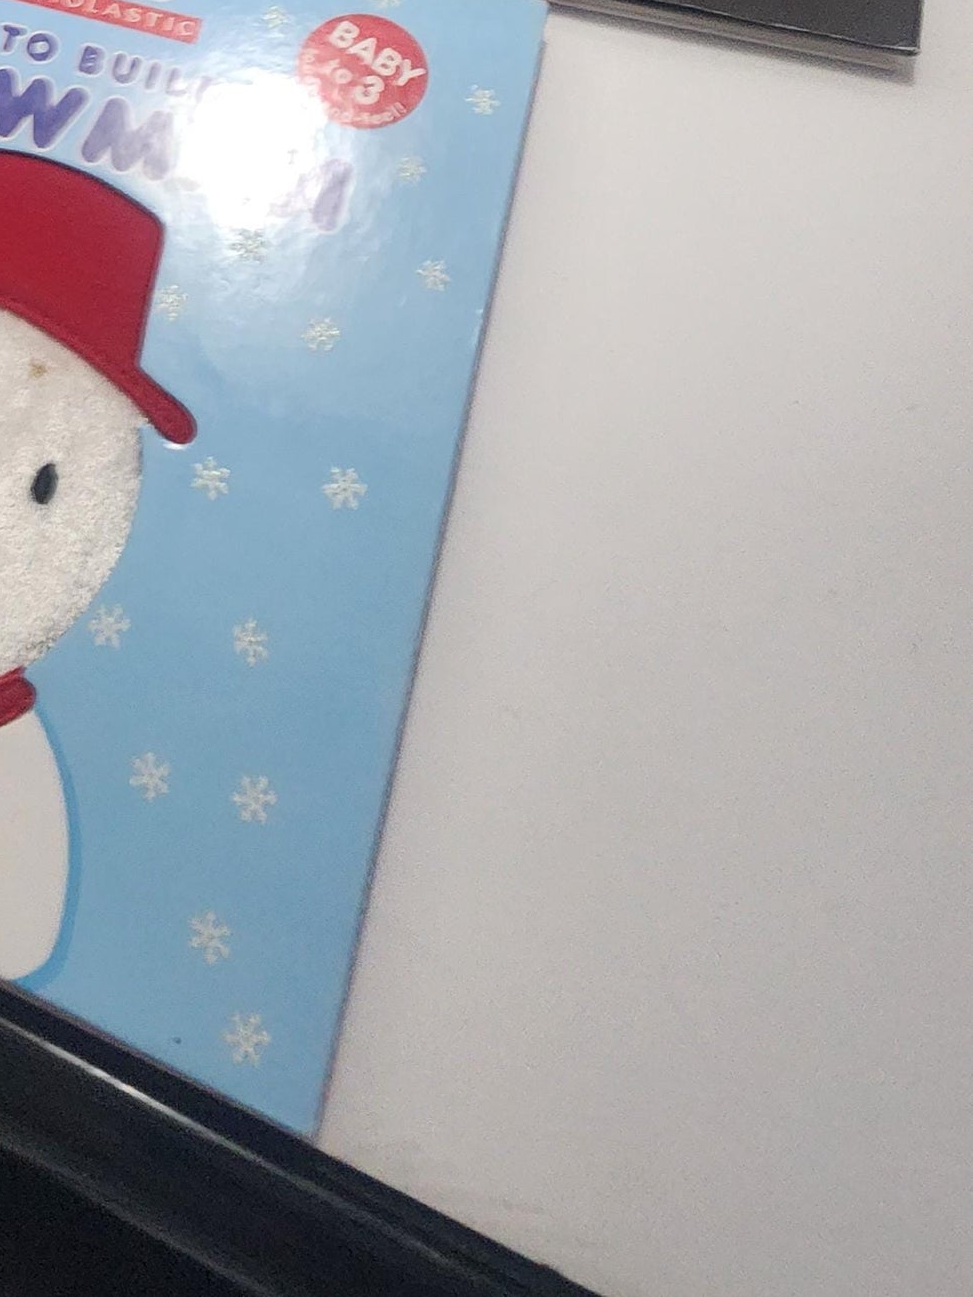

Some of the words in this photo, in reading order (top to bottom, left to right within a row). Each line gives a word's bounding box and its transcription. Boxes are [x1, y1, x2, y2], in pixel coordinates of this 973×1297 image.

[1, 23, 61, 64] TO
[328, 20, 426, 87] BABY
[318, 59, 353, 85] to
[354, 75, 385, 105] 3
